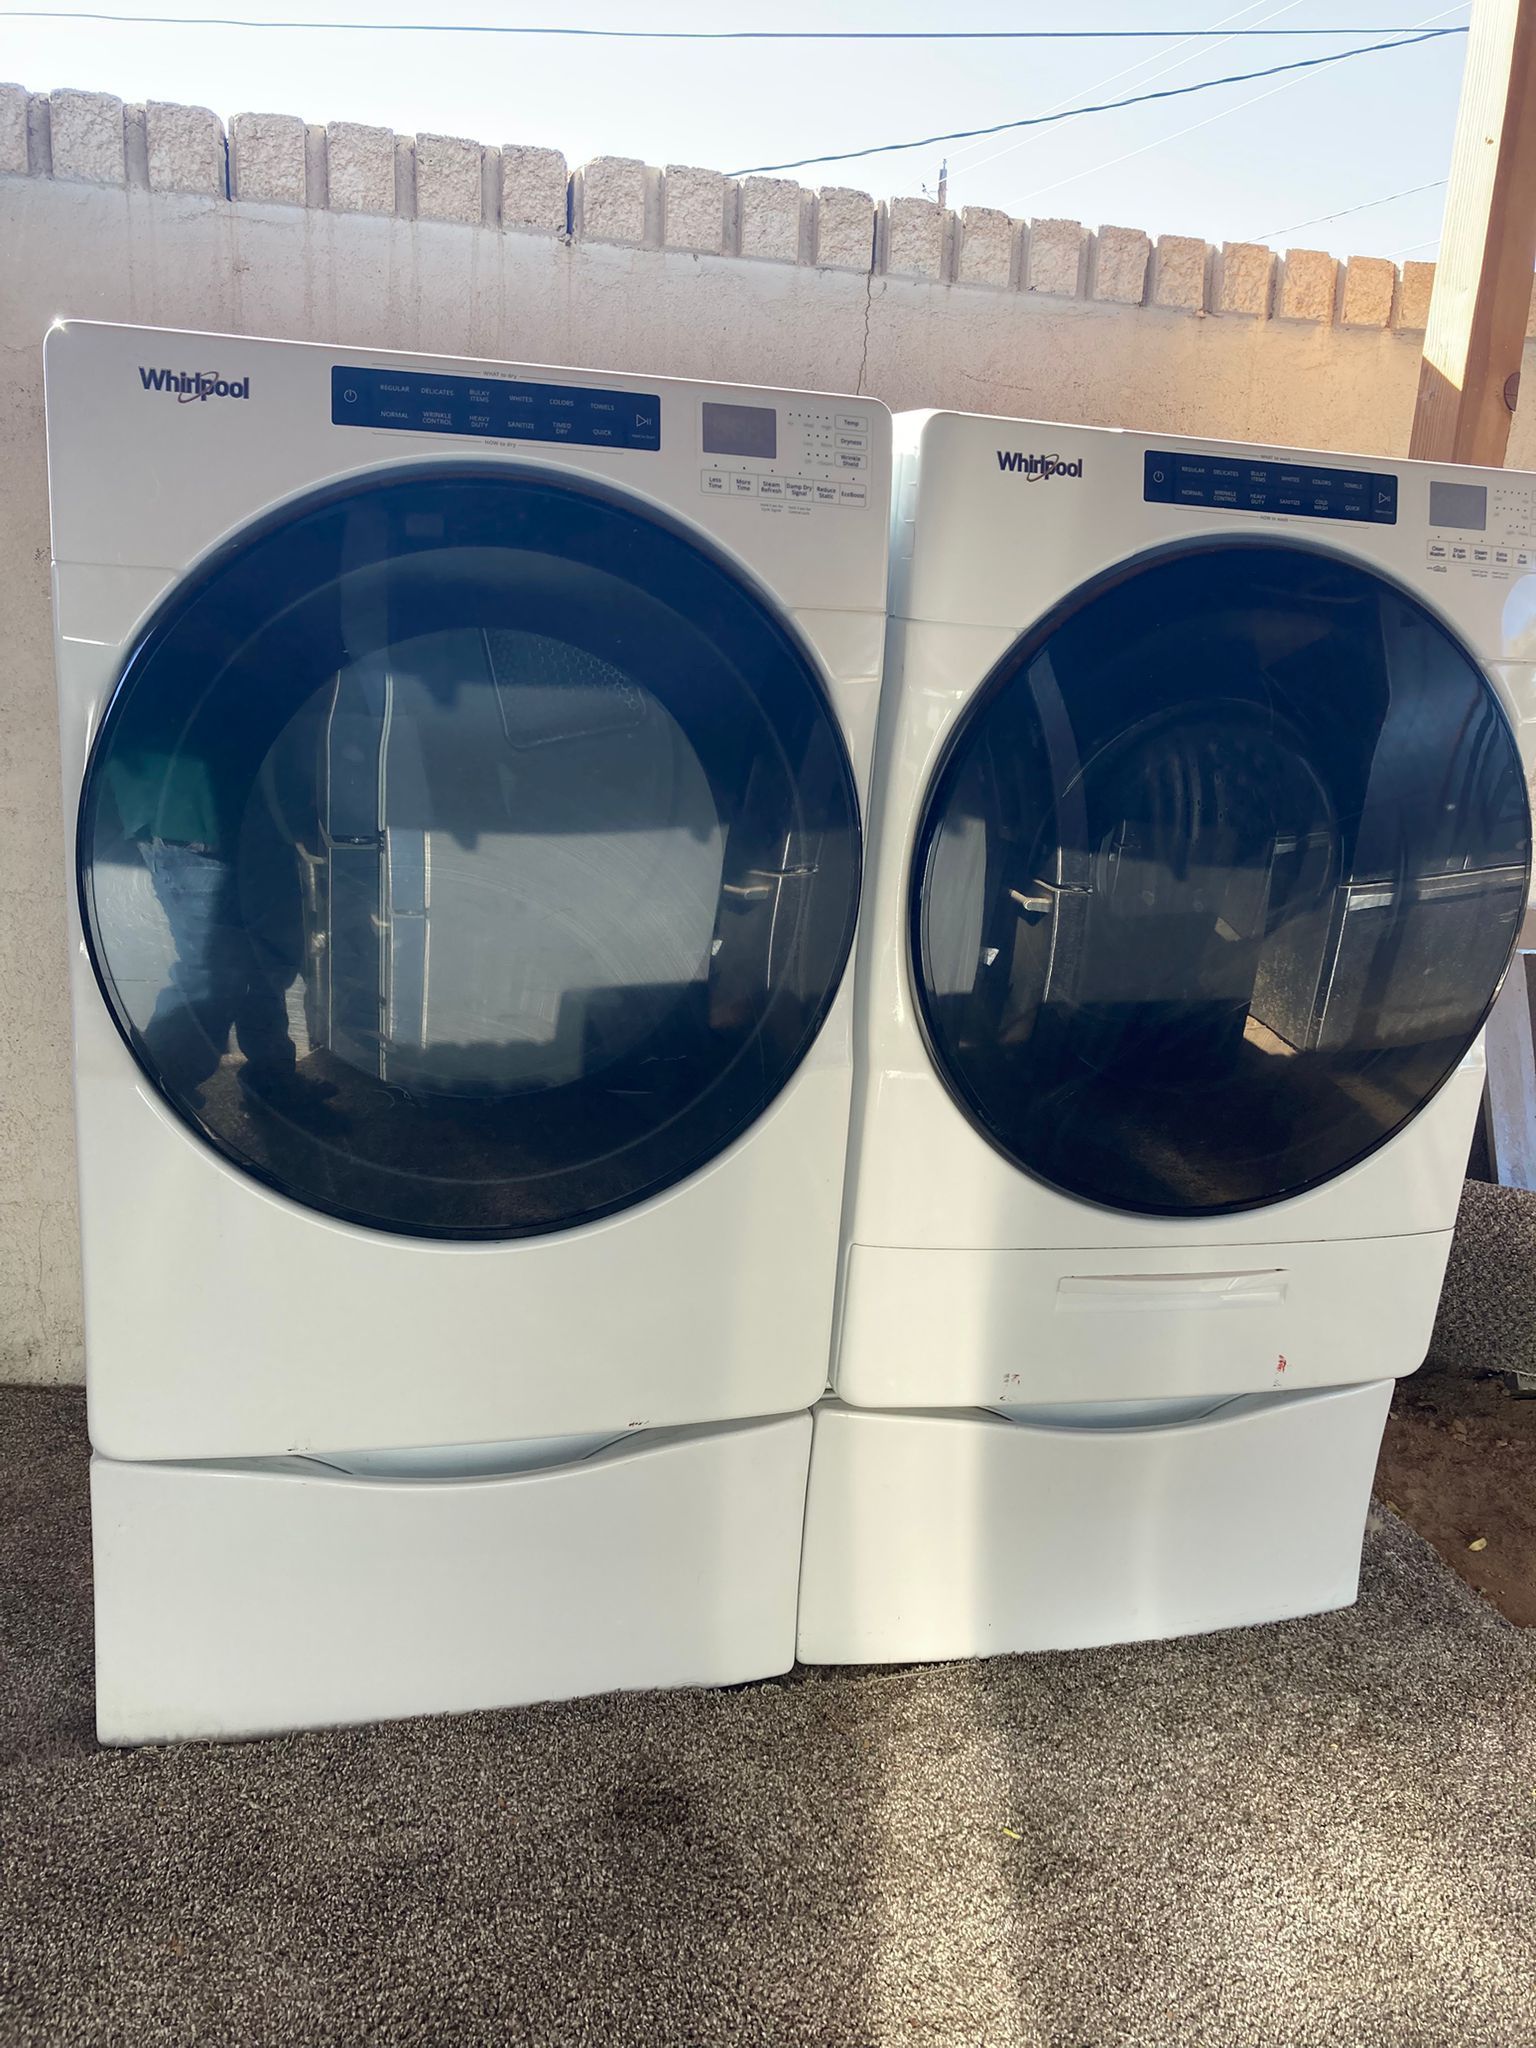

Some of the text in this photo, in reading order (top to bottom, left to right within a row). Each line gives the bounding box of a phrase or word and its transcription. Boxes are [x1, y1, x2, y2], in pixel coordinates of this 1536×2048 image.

[138, 366, 249, 402] Whirlpool
[380, 384, 410, 393] REGULAR
[421, 387, 454, 396] DELICATES
[509, 395, 533, 403] WHITES
[549, 399, 574, 407] COLORS
[591, 402, 615, 411] TOWELS
[380, 410, 409, 419] NORMAL
[423, 410, 451, 419] WRINKLE
[423, 417, 453, 426] CONTROL
[471, 420, 488, 428] DUTY
[507, 421, 534, 430] SANITIZE
[552, 421, 571, 429] TIMED
[844, 419, 859, 427] Temp
[592, 428, 612, 436] QUICK
[840, 438, 862, 446] Dryness
[997, 450, 1083, 481] Whirlpool
[1181, 466, 1205, 474] REGULAR
[1212, 468, 1239, 477] DELICATES
[708, 482, 722, 490] Time
[736, 478, 751, 486] More
[762, 480, 781, 488] Steam
[760, 486, 782, 495] Refresh
[786, 482, 813, 493] Damp Dry
[816, 486, 837, 494] Reduce
[791, 489, 808, 498] Signal
[1181, 489, 1204, 497] NORMAL
[1214, 489, 1237, 497] WRINKLE
[1213, 495, 1237, 503] CONTROL
